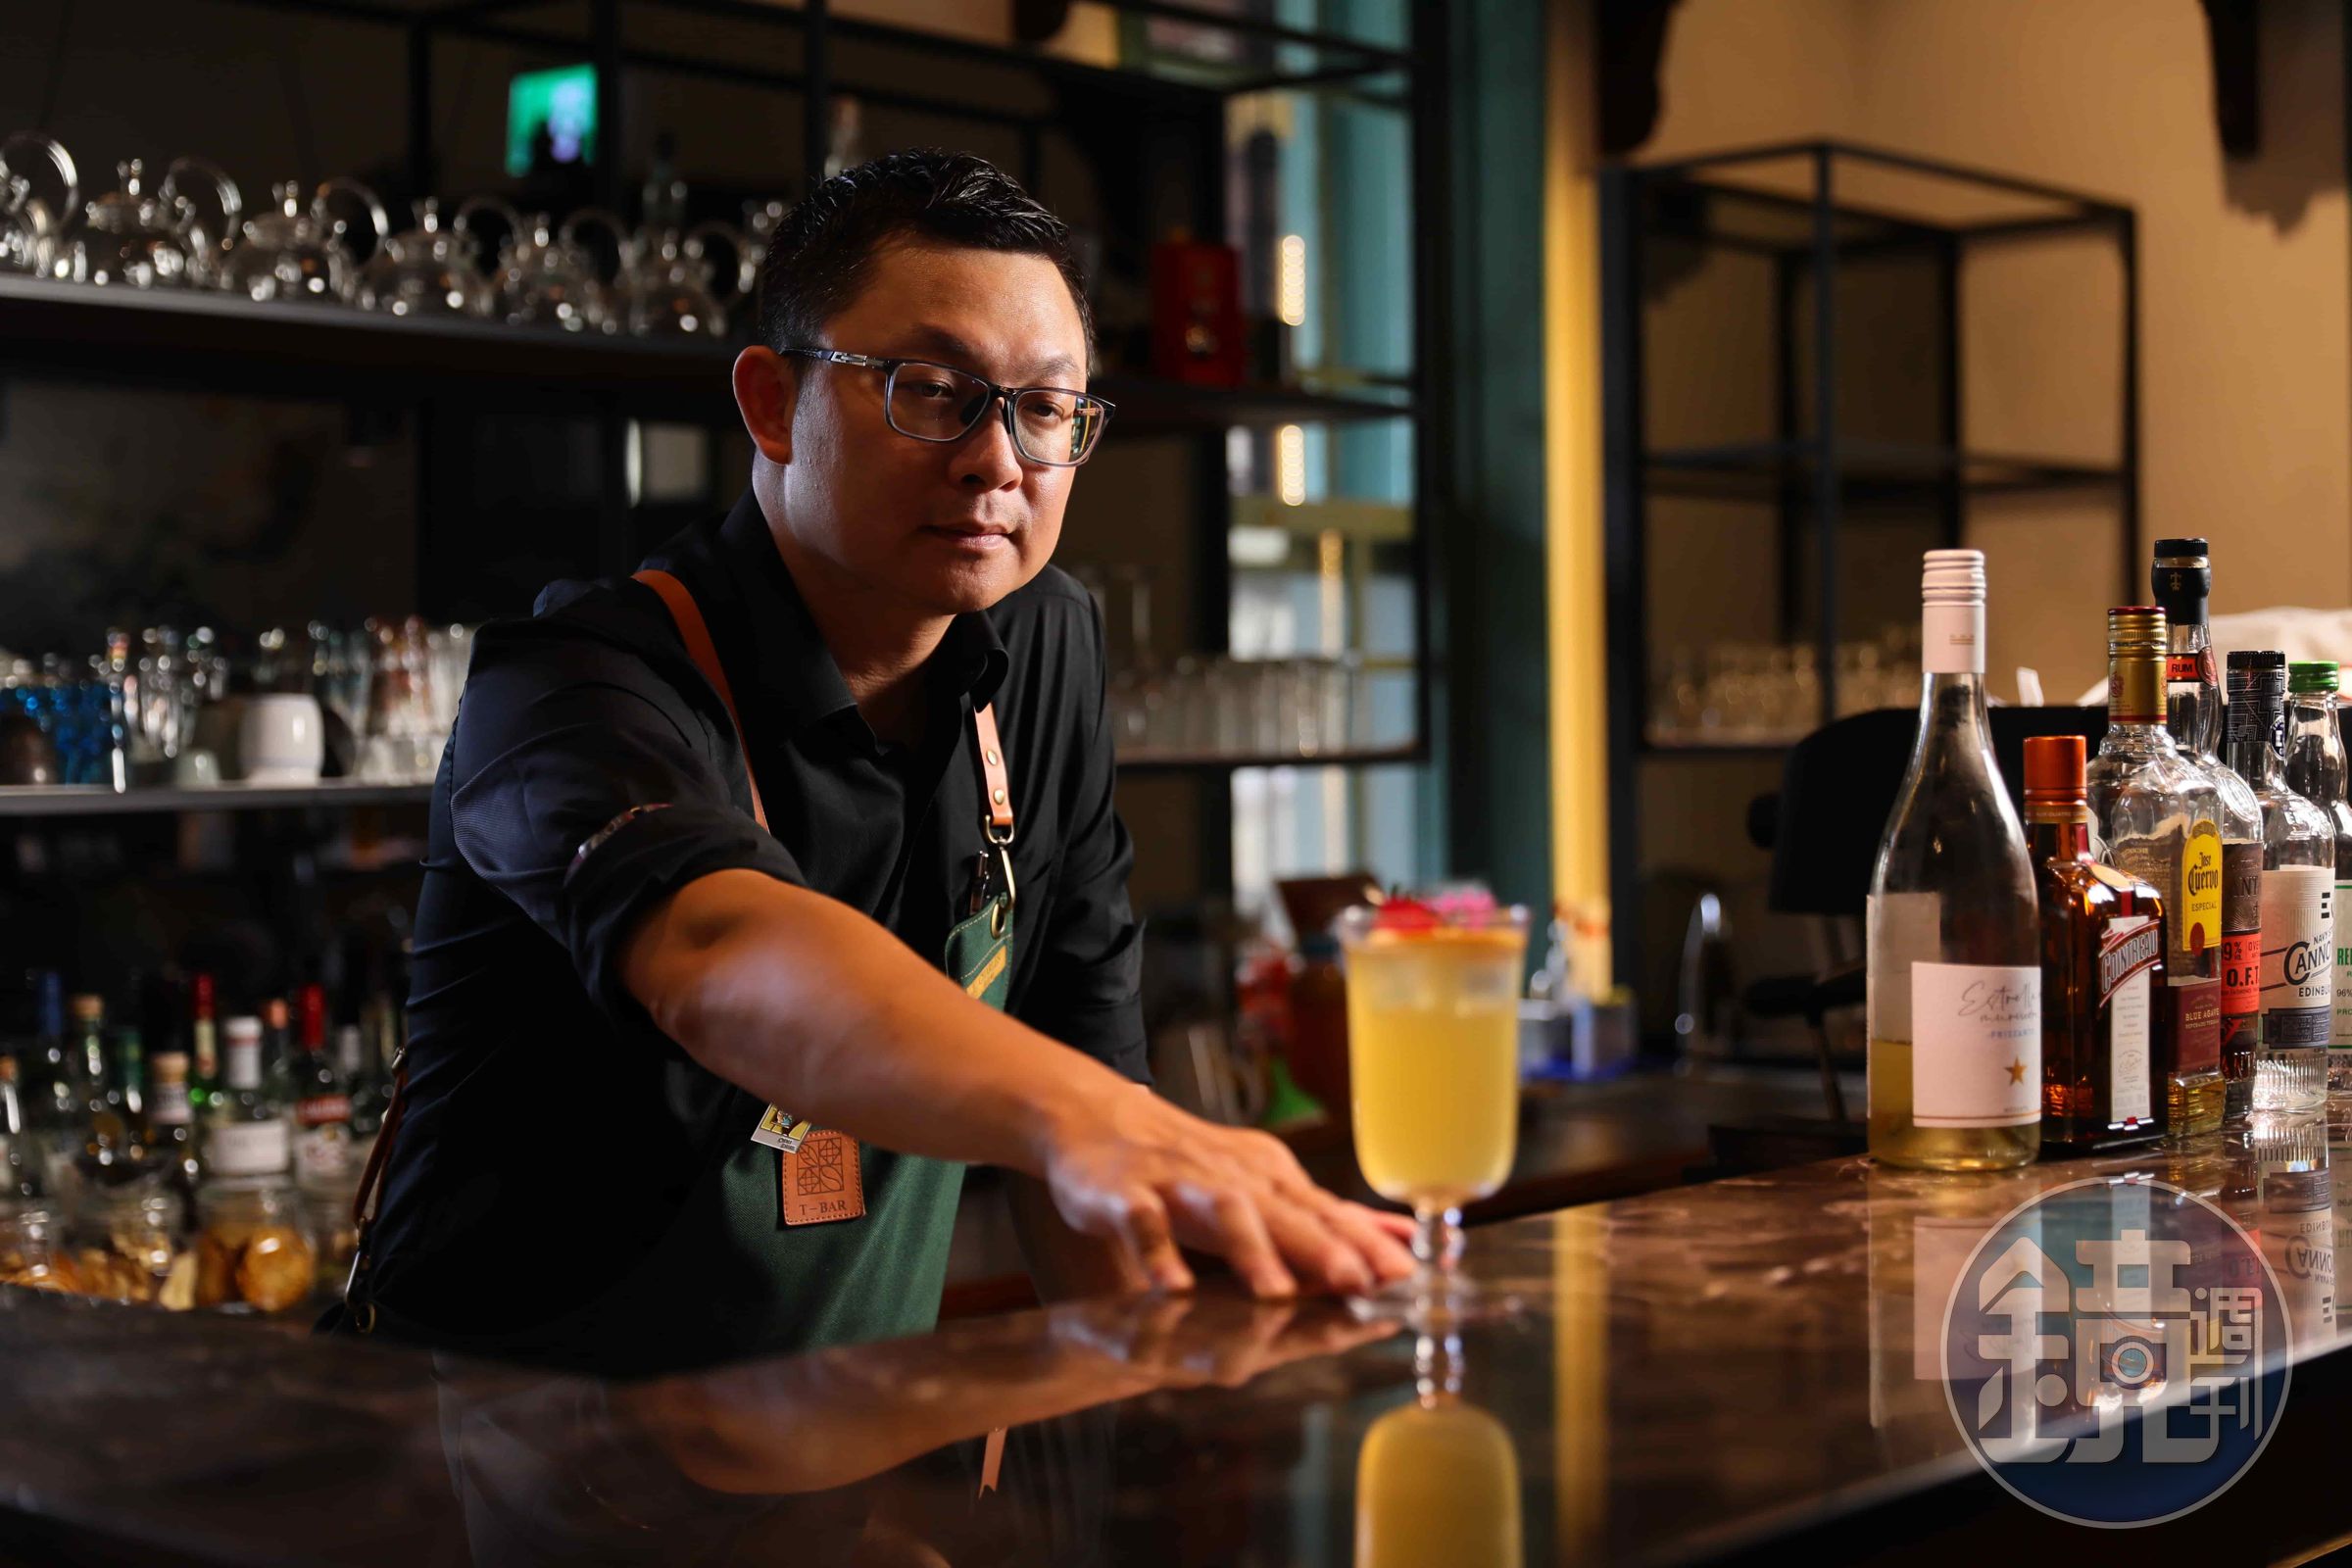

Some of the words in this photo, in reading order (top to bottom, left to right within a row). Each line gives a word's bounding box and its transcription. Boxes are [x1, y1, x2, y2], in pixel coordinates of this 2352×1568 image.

[2171, 663, 2193, 673] RUM
[2198, 852, 2212, 868] Jose
[2187, 863, 2219, 897] Cuervo
[2191, 901, 2218, 912] ESPECIAL
[2101, 928, 2158, 995] COINTREAU
[2184, 1011, 2202, 1021] BLUE
[2202, 1007, 2220, 1019] AGAVE
